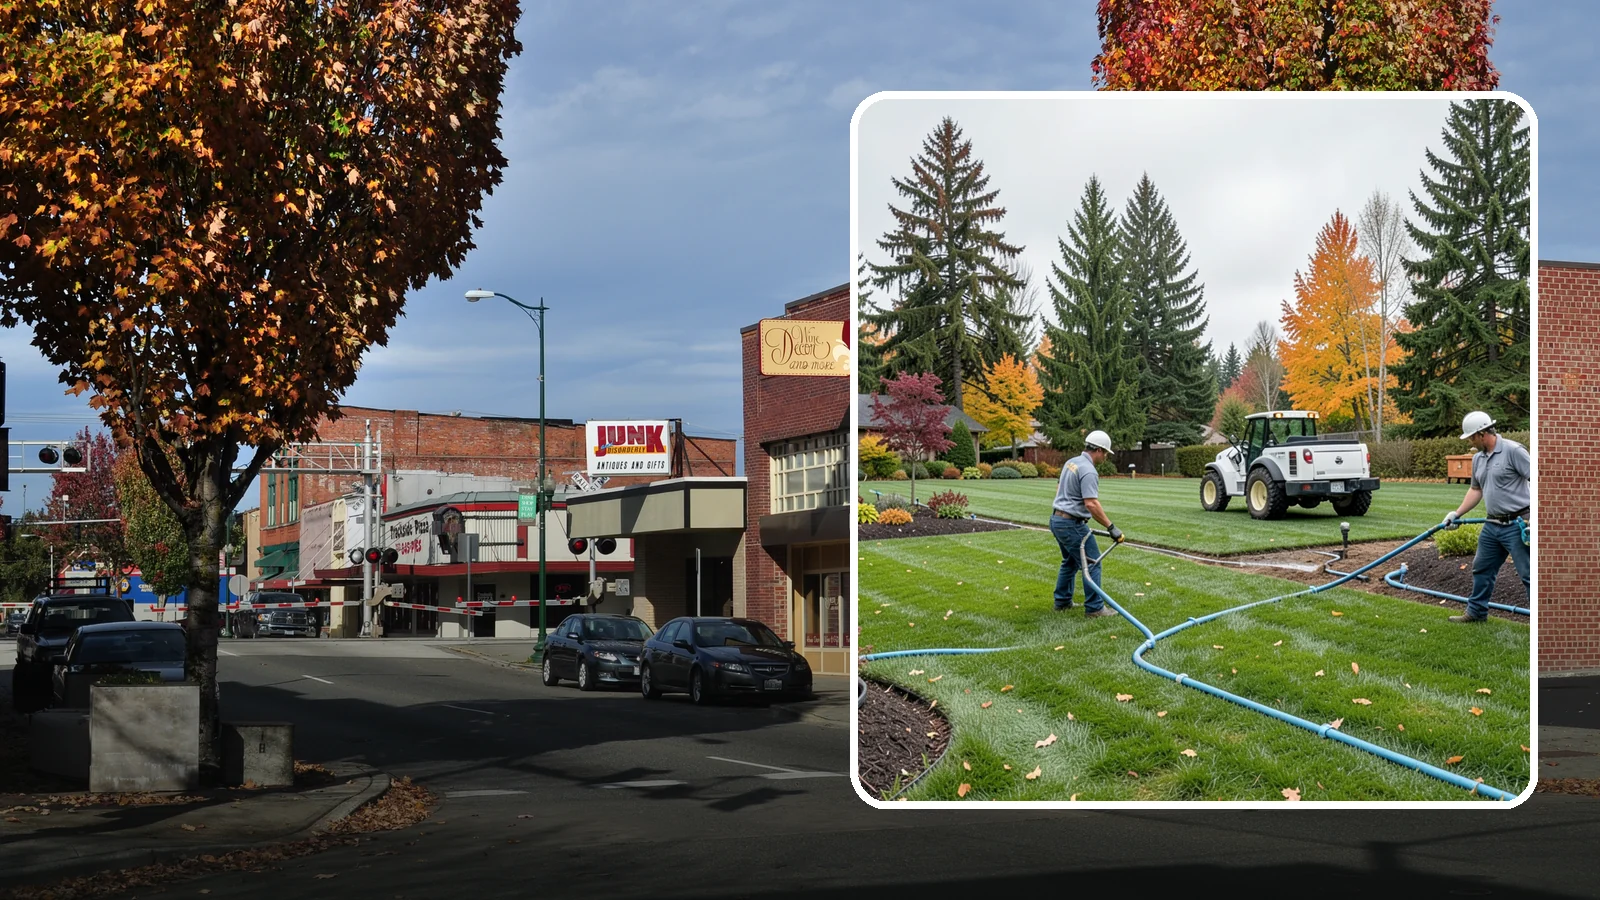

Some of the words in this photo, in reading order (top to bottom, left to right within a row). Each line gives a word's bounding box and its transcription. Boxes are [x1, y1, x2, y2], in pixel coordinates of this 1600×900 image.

[596, 425, 665, 457] JUNK
[607, 446, 646, 454] DISORDERLY
[597, 461, 628, 470] ANTIQUES
[631, 461, 643, 469] AND
[647, 460, 665, 469] GIFTS
[414, 519, 429, 535] Pizza
